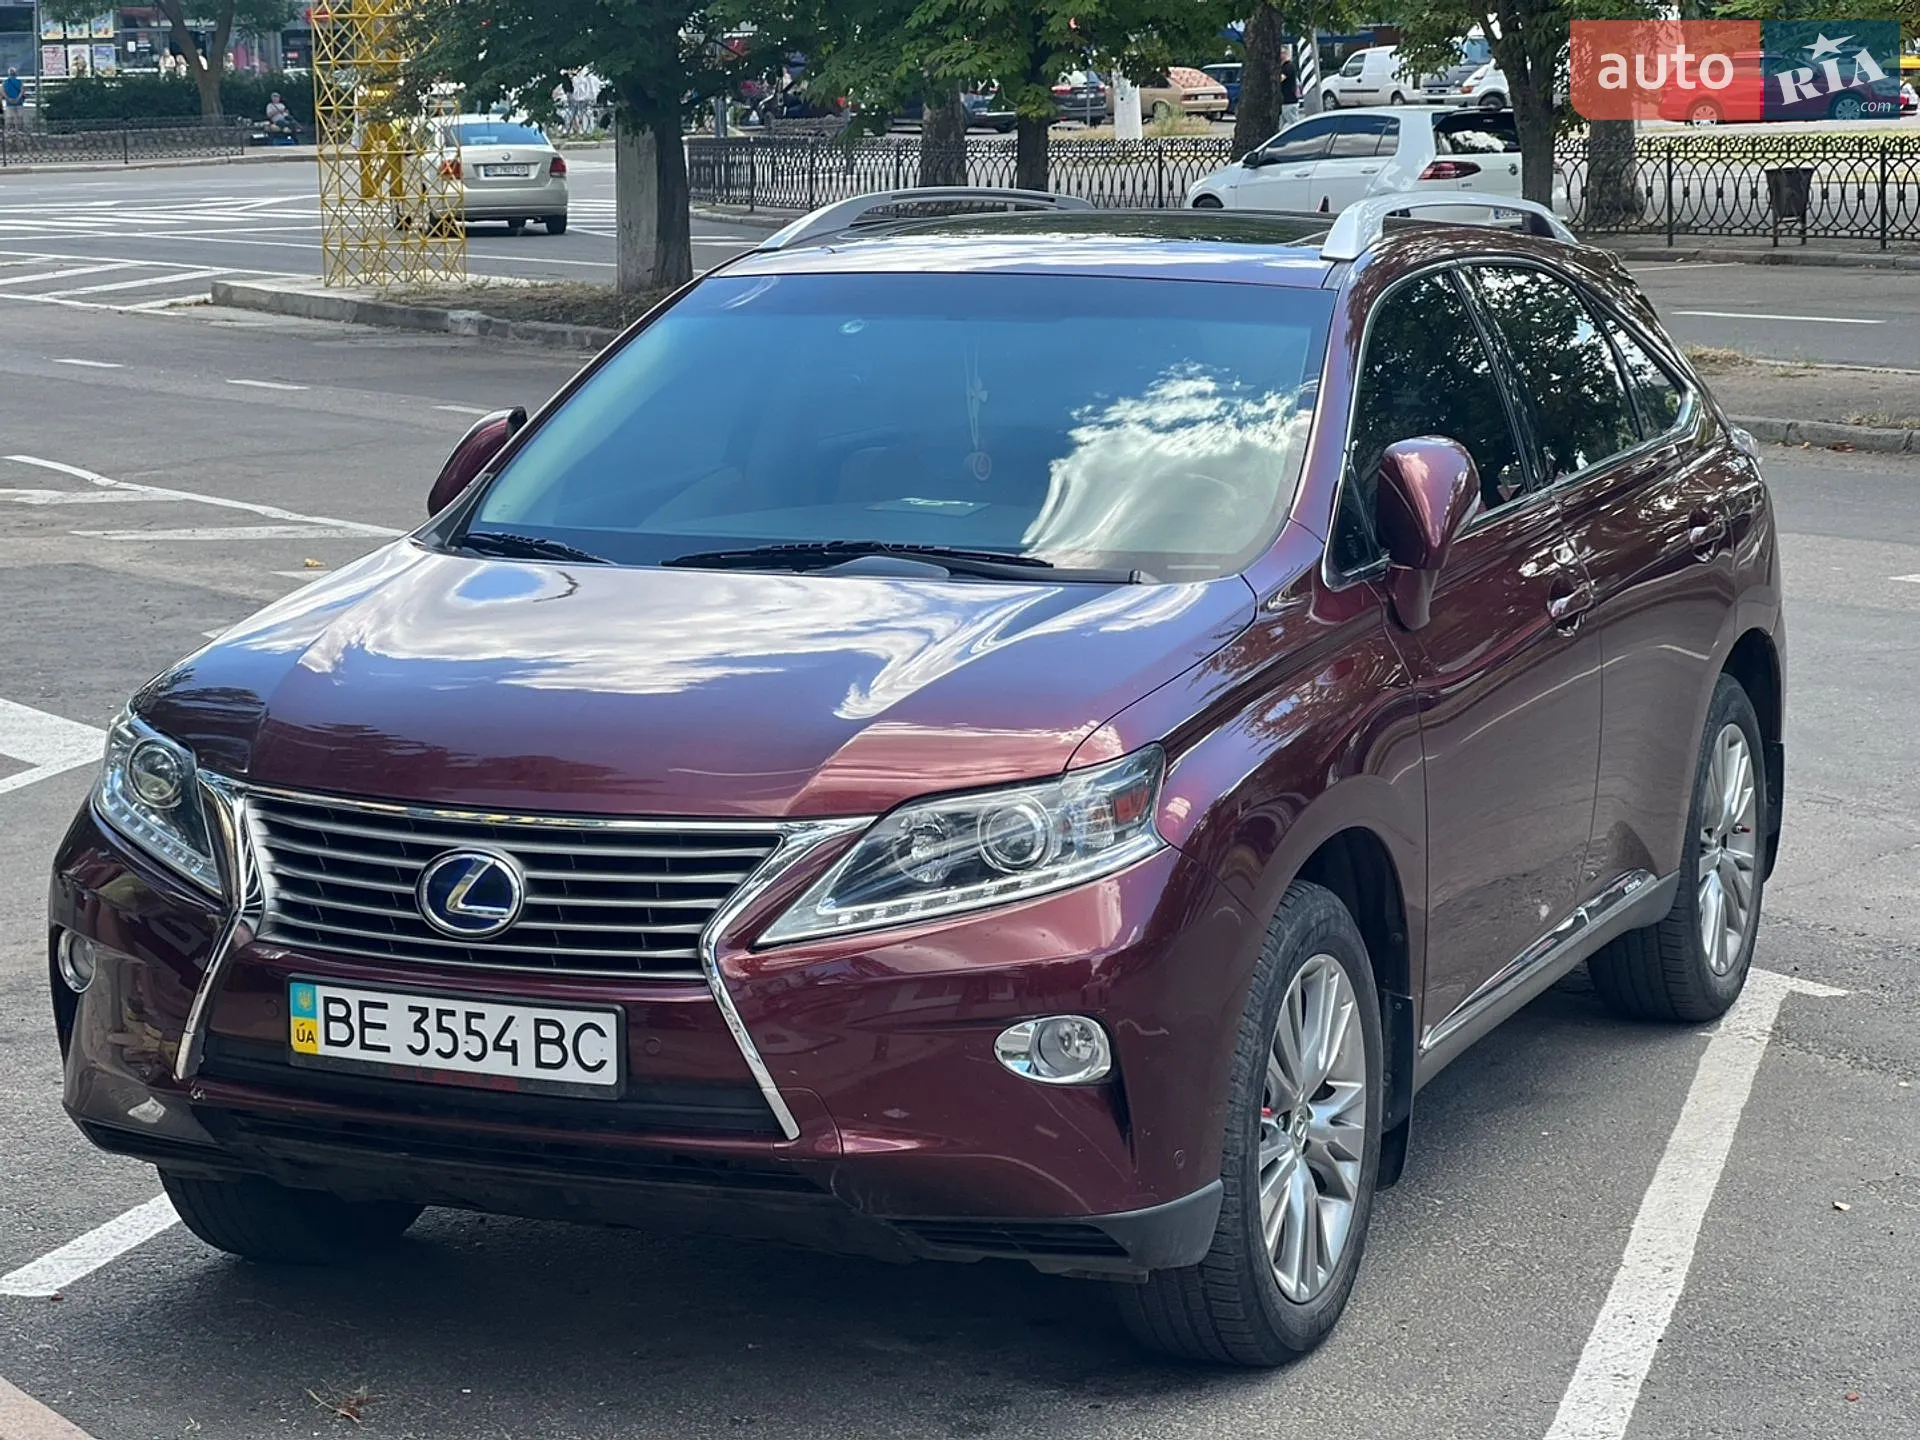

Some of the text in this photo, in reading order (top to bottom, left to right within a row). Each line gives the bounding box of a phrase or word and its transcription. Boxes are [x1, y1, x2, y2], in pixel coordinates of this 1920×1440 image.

[323, 996, 608, 1073] BE 3554 BC
